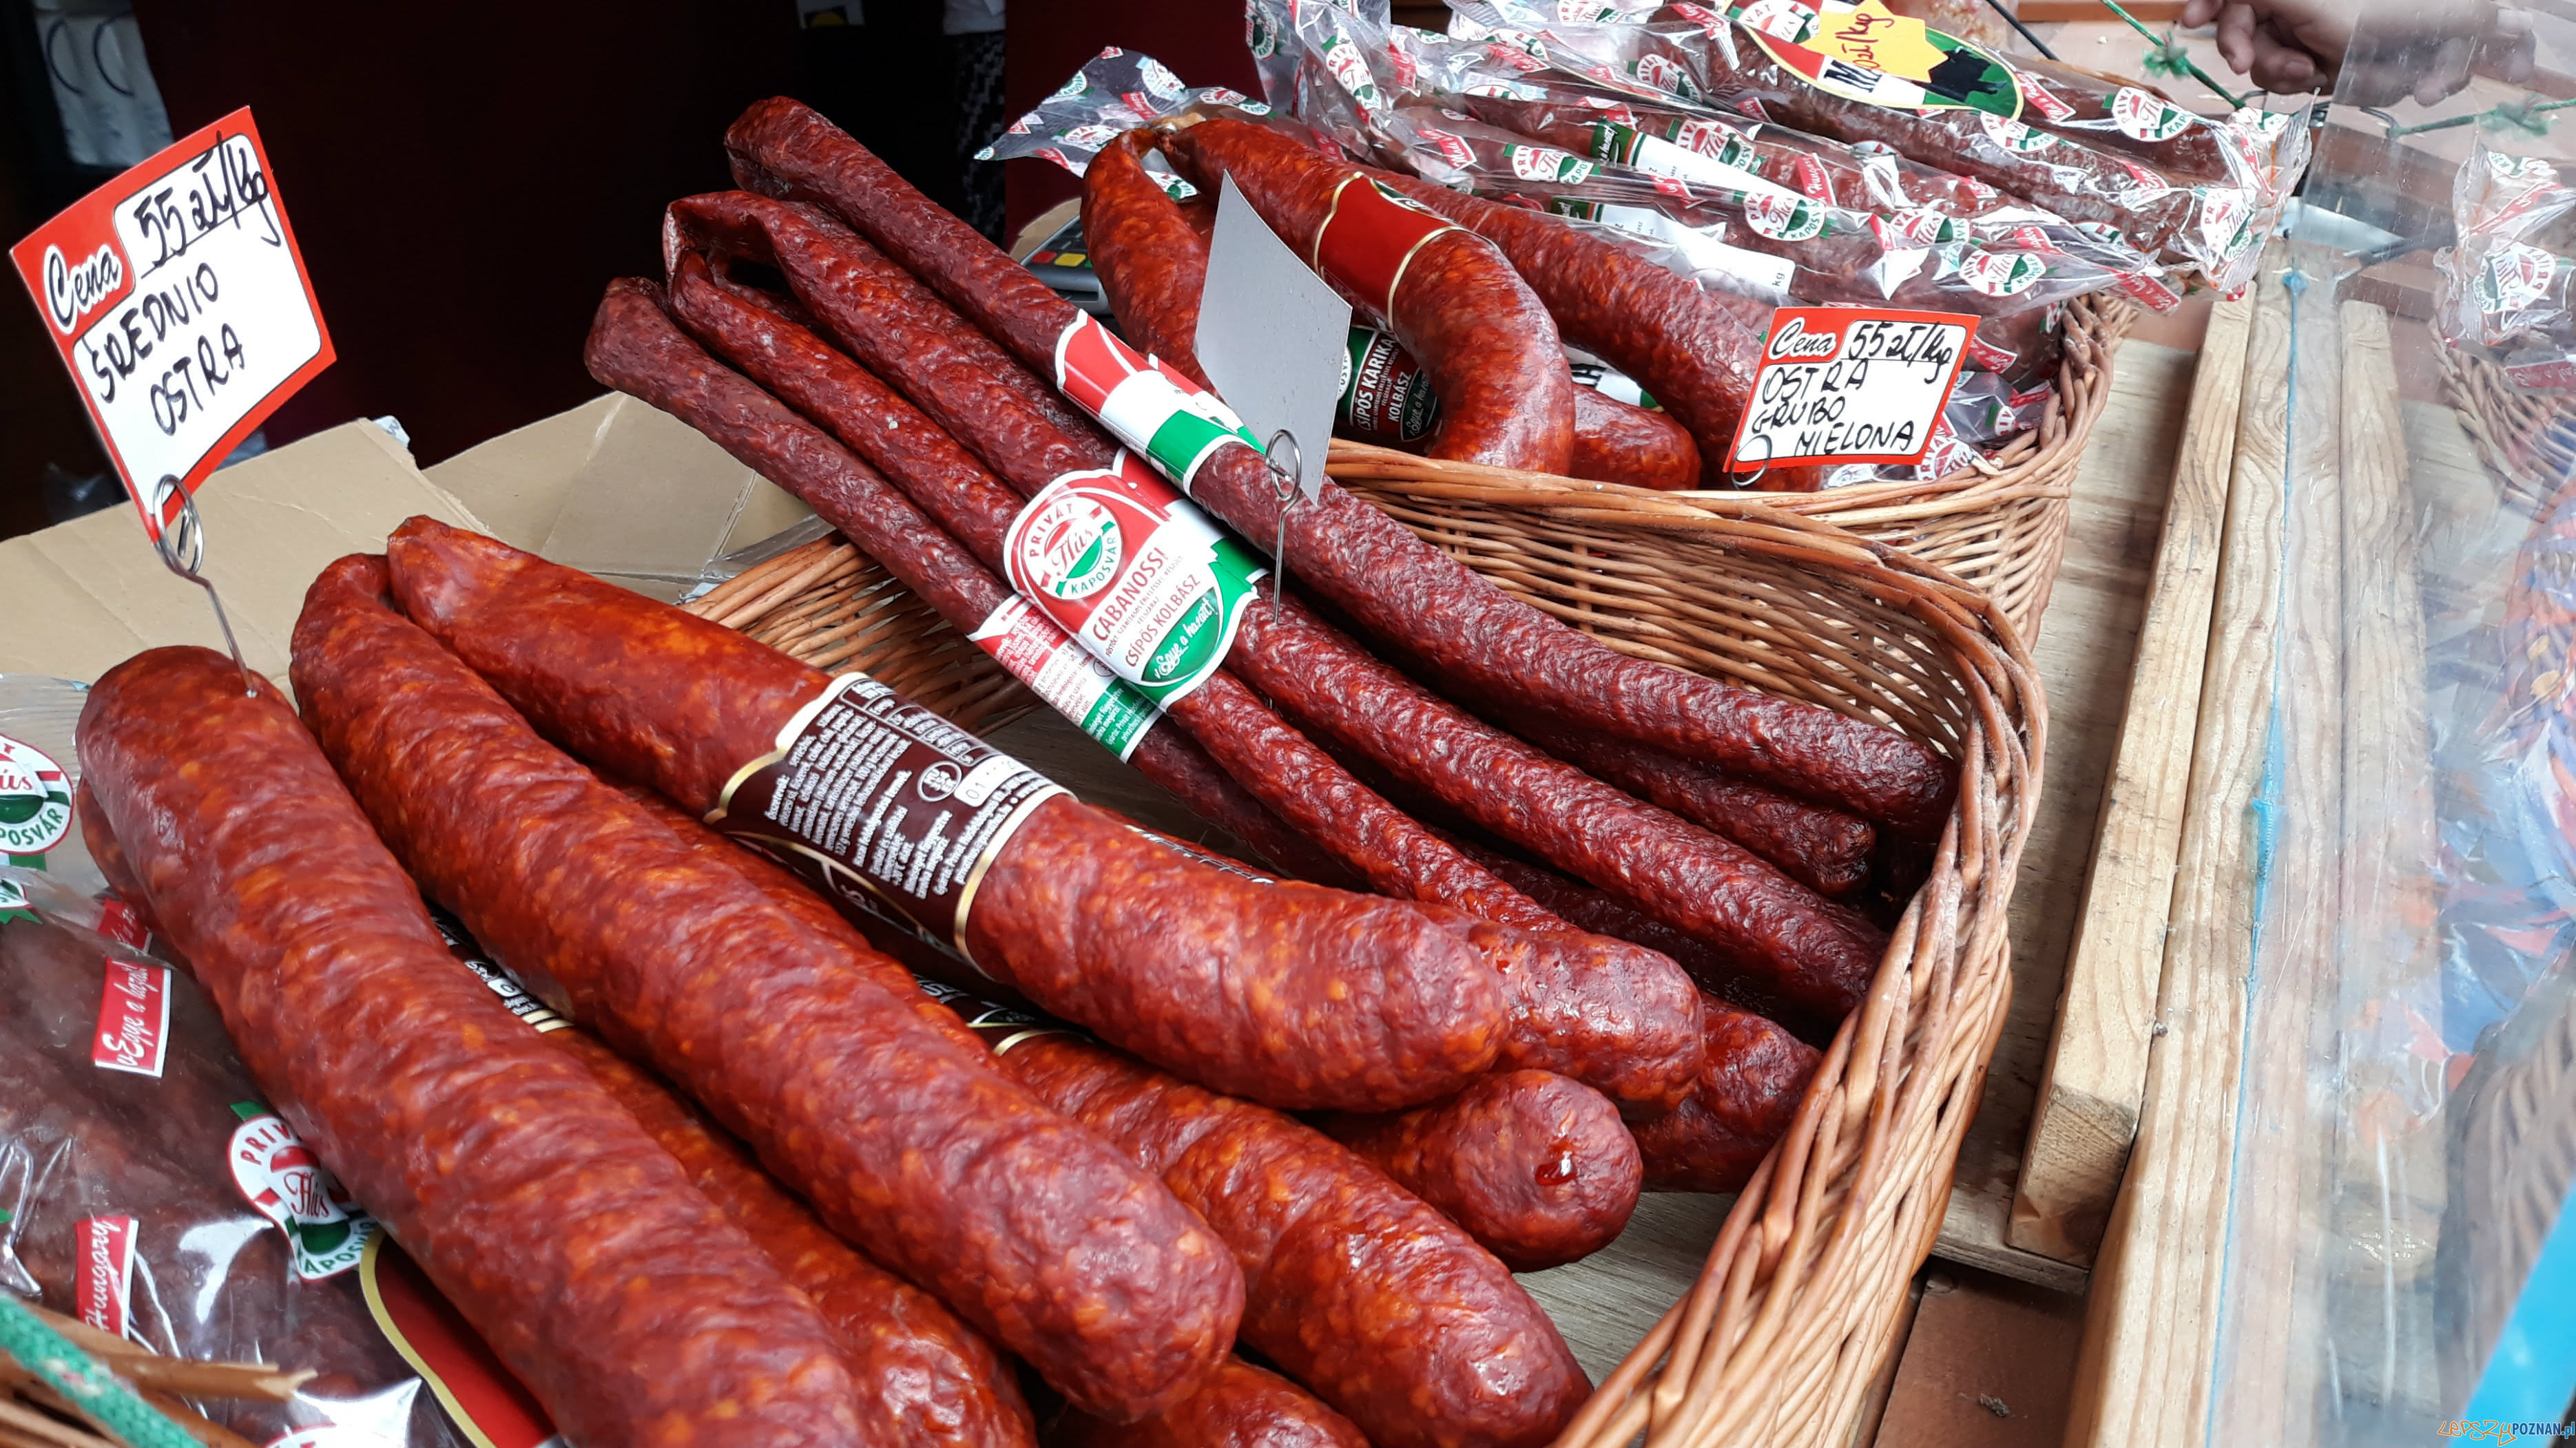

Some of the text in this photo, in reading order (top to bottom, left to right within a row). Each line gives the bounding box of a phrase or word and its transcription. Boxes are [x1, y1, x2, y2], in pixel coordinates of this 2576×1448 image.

[48, 251, 120, 327] Cena
[81, 262, 219, 403] ŚREDNIO
[1772, 321, 1836, 356] Cena
[150, 324, 245, 436] OSTRA
[1362, 337, 1397, 390] KARIKA
[1762, 358, 1869, 405] OSTRA
[1388, 371, 1413, 423] KOLBÁSZ
[1752, 396, 1845, 434] GRUBO
[1794, 421, 1915, 456] MIELONA
[1029, 503, 1073, 557] PRIVÁT
[1052, 528, 1093, 576] Hús
[1071, 536, 1116, 594] KAPOSVÁR
[1092, 547, 1170, 642] CABANOSSI
[1152, 572, 1200, 627] KOLBÁSZ
[1178, 636, 1190, 646] a
[765, 704, 844, 820] Összetevők: sertéshús, szalonna,
[808, 742, 826, 761] cukor,
[855, 766, 871, 780] 100
[842, 804, 862, 839] sertéshús
[858, 795, 891, 846] feldolgozású
[884, 767, 912, 798] termék.
[882, 805, 908, 840] szállítási
[898, 839, 915, 863] alatt.
[917, 810, 953, 854] függesztve
[925, 835, 951, 872] megőrzi:
[933, 865, 953, 896] Gyártó:
[944, 843, 966, 868] Privát
[133, 999, 145, 1013] a
[284, 1171, 330, 1219] Hús
